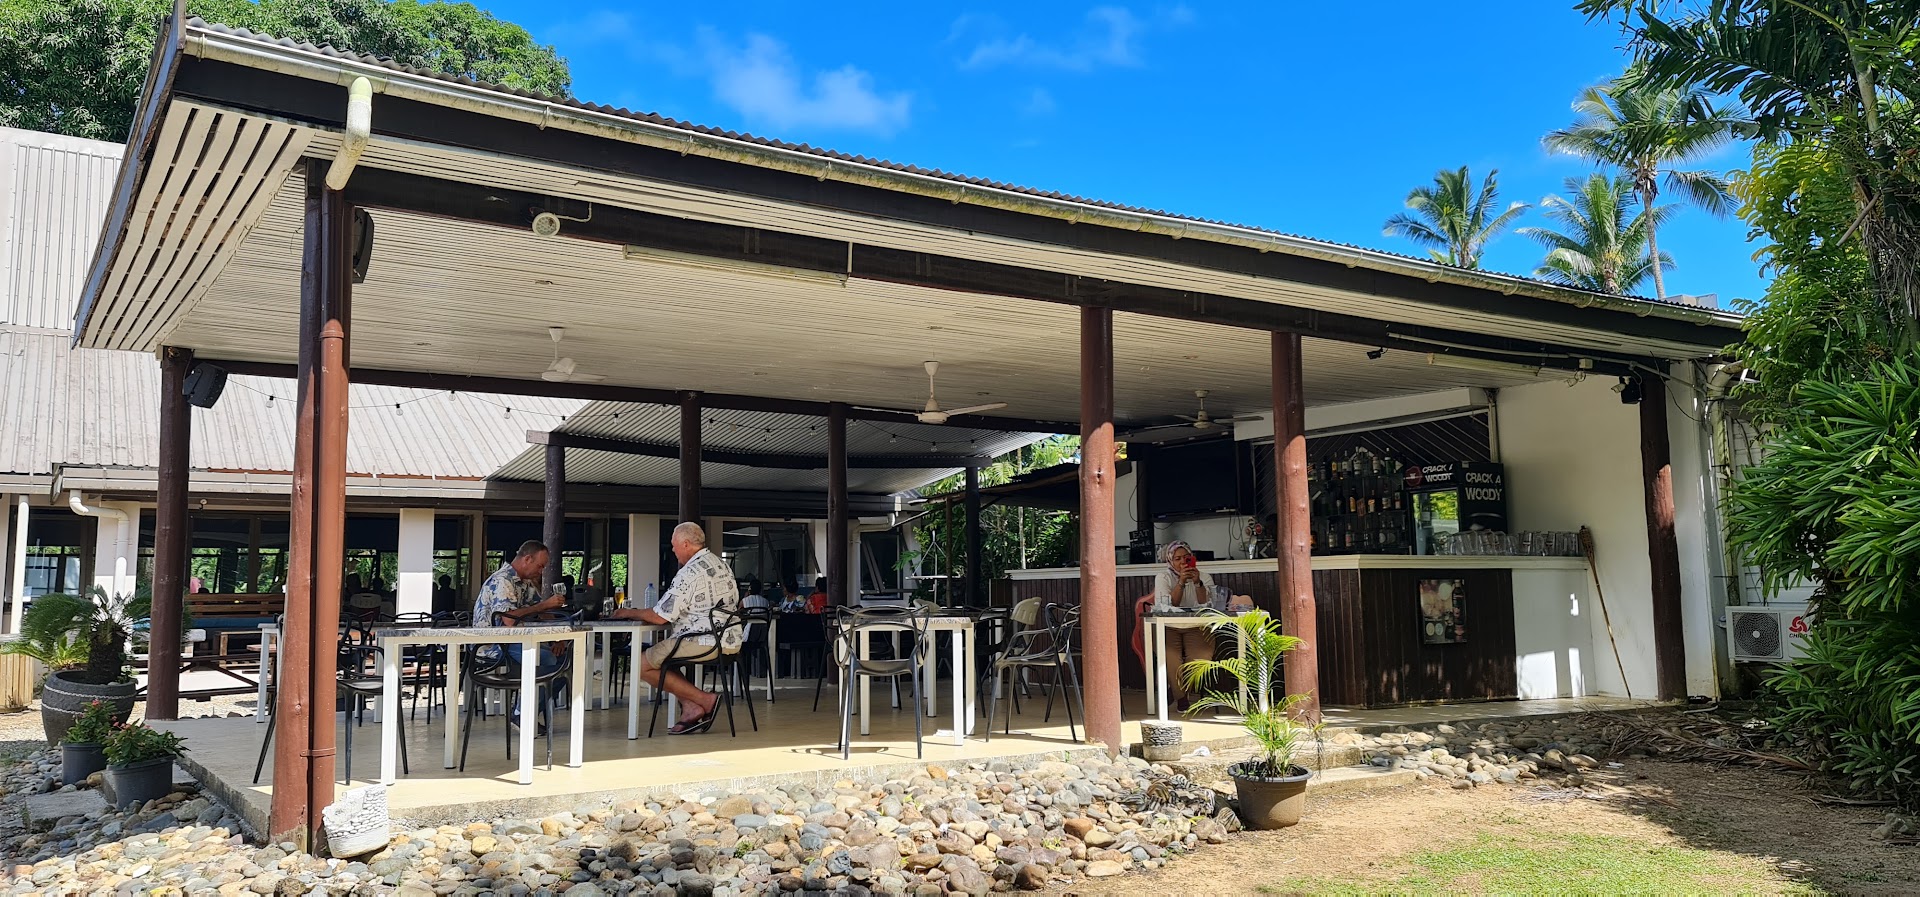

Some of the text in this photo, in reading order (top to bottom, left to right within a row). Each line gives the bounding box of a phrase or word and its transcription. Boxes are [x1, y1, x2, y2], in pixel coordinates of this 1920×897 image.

[1422, 464, 1447, 474] CRACK
[1425, 473, 1453, 482] WOODY
[1465, 472, 1502, 484] CRACK A
[1465, 487, 1503, 501] WOODY
[1132, 530, 1149, 538] EAT
